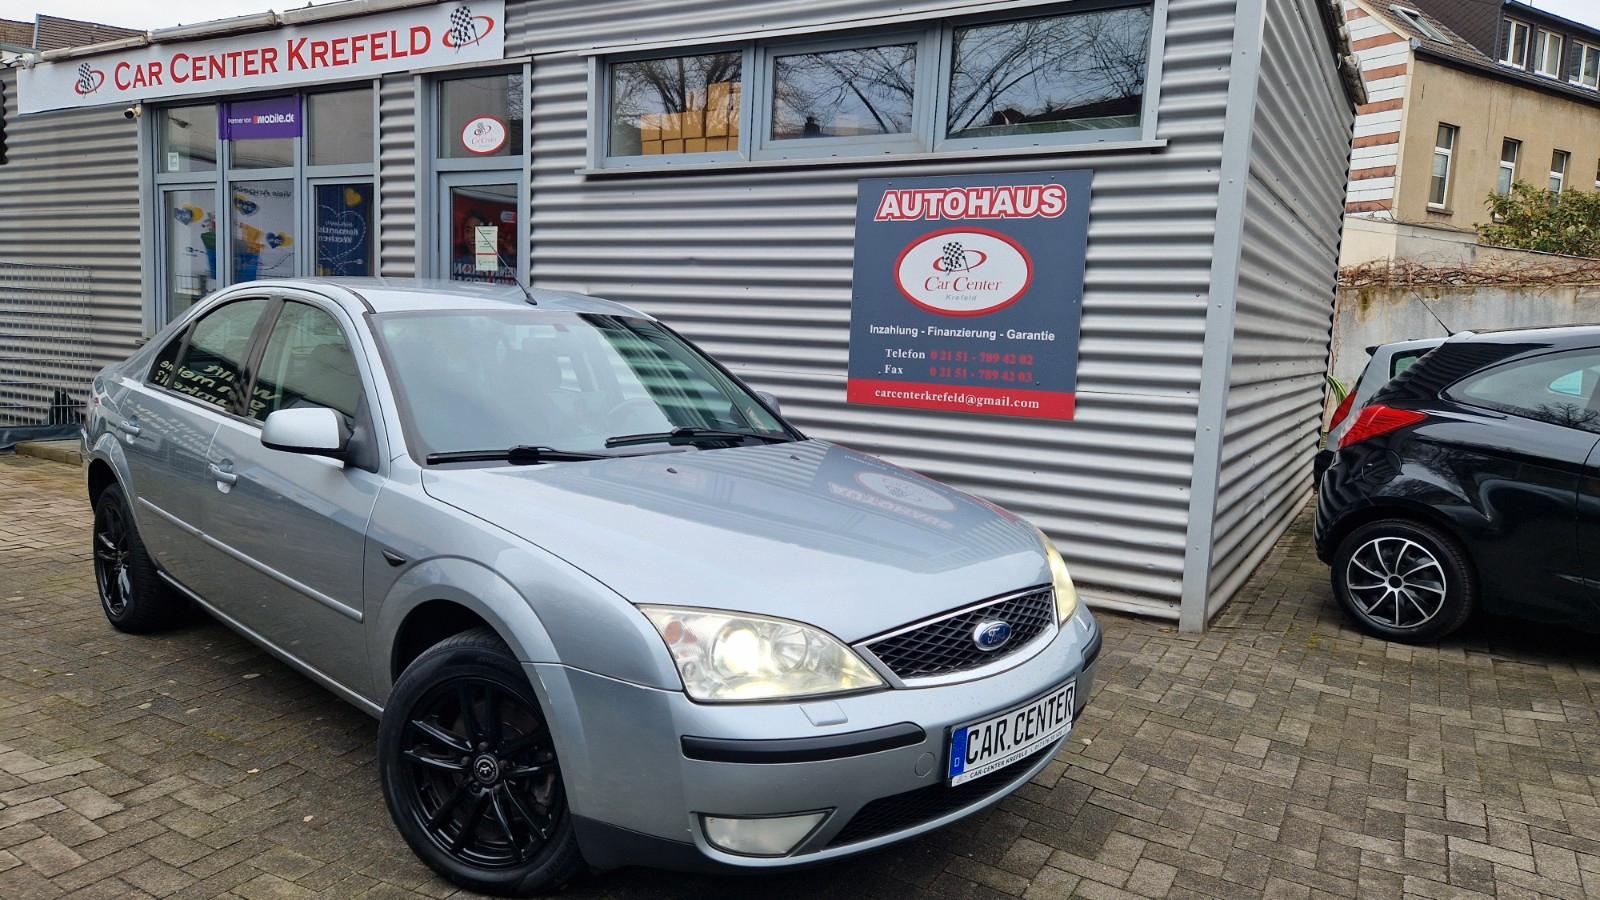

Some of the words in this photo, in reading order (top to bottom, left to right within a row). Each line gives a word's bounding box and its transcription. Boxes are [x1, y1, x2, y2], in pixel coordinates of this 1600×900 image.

[114, 61, 163, 91] CAR
[169, 47, 279, 83] CENTER
[287, 26, 431, 71] KREFELD
[874, 184, 1067, 222] AUTOHAUS
[924, 276, 950, 292] Car
[952, 276, 1002, 292] Center
[945, 294, 978, 302] Krefeld
[869, 324, 919, 338] Inzahlung
[927, 326, 997, 341] Finanzierung
[1006, 329, 1056, 342] Garantie
[885, 348, 926, 360] Telefon
[884, 364, 904, 375] Fax
[875, 388, 1040, 409] carcenterkrefeld@gmail.com
[954, 757, 960, 768] D
